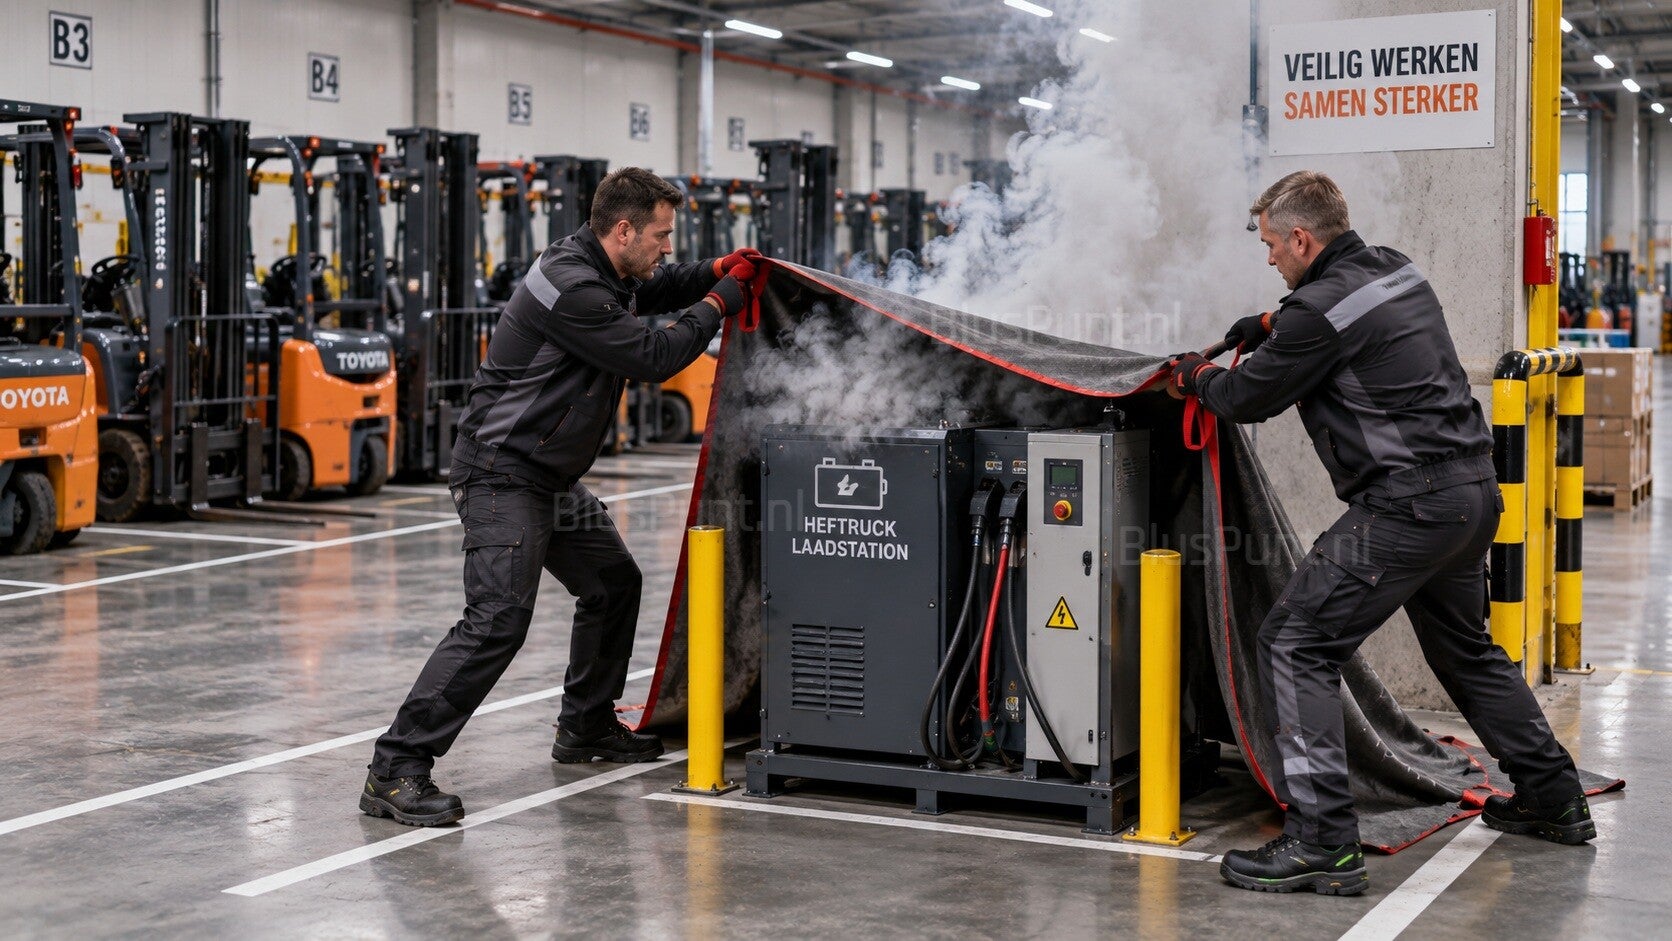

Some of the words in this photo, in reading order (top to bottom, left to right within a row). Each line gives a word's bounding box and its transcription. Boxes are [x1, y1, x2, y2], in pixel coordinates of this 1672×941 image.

[53, 19, 89, 62] B3
[1284, 50, 1362, 81] VEILIG
[1371, 42, 1478, 76] WERKEN
[311, 62, 338, 93] B4
[510, 89, 531, 119] B5
[1284, 89, 1366, 120] SAMEN
[1373, 83, 1478, 116] STERKER
[337, 351, 389, 370] TOYOTA
[0, 386, 70, 410] OYOTA
[804, 516, 897, 538] HEFTRUCK
[792, 539, 908, 561] LAADSTATION
